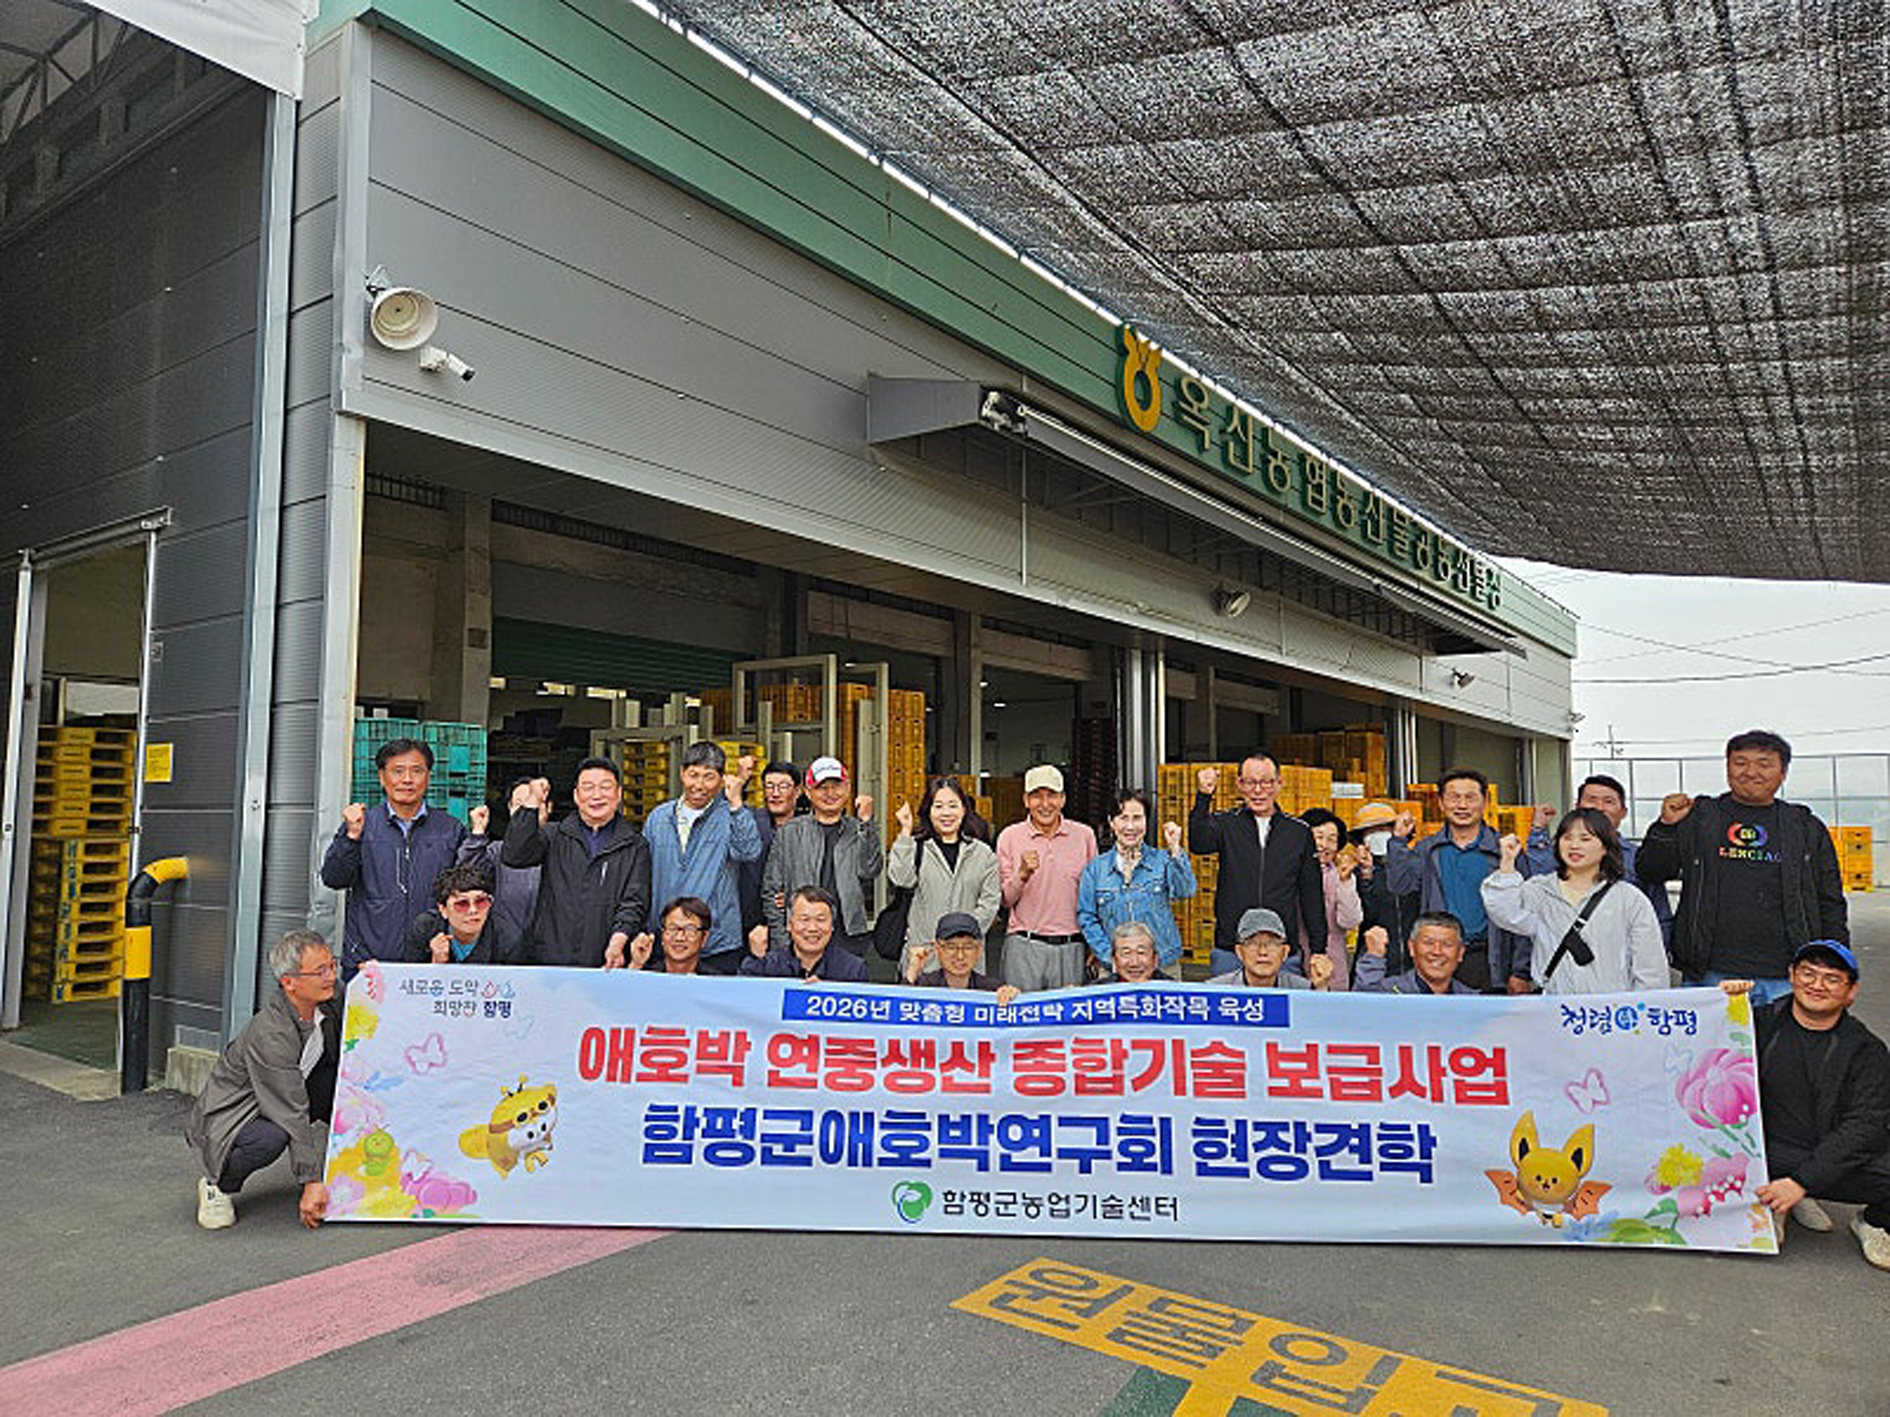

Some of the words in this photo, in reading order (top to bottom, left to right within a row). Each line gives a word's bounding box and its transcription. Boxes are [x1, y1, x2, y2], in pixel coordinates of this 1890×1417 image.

[399, 979, 444, 998] 새로운
[448, 979, 479, 998] 도약
[433, 1000, 478, 1018] 희망찬
[483, 1000, 512, 1019] 함평
[806, 995, 892, 1021] 2026년
[900, 1001, 965, 1023] 맞춤형
[974, 1001, 1064, 1025] 미래전략
[1071, 994, 1210, 1022] 지역특화작목
[1218, 997, 1265, 1022] 육성
[1560, 1003, 1613, 1036] 청렴
[1646, 1006, 1698, 1036] 함평
[578, 1025, 753, 1088] 애호박
[765, 1032, 998, 1093] 연중생산
[1010, 1036, 1248, 1099] 종합기술
[1264, 1041, 1510, 1107] 보급사업
[642, 1103, 1174, 1176] 함평군애호박연구회
[1191, 1115, 1438, 1185] 현장견학
[942, 1189, 1179, 1222] 함평군농업기술센터
